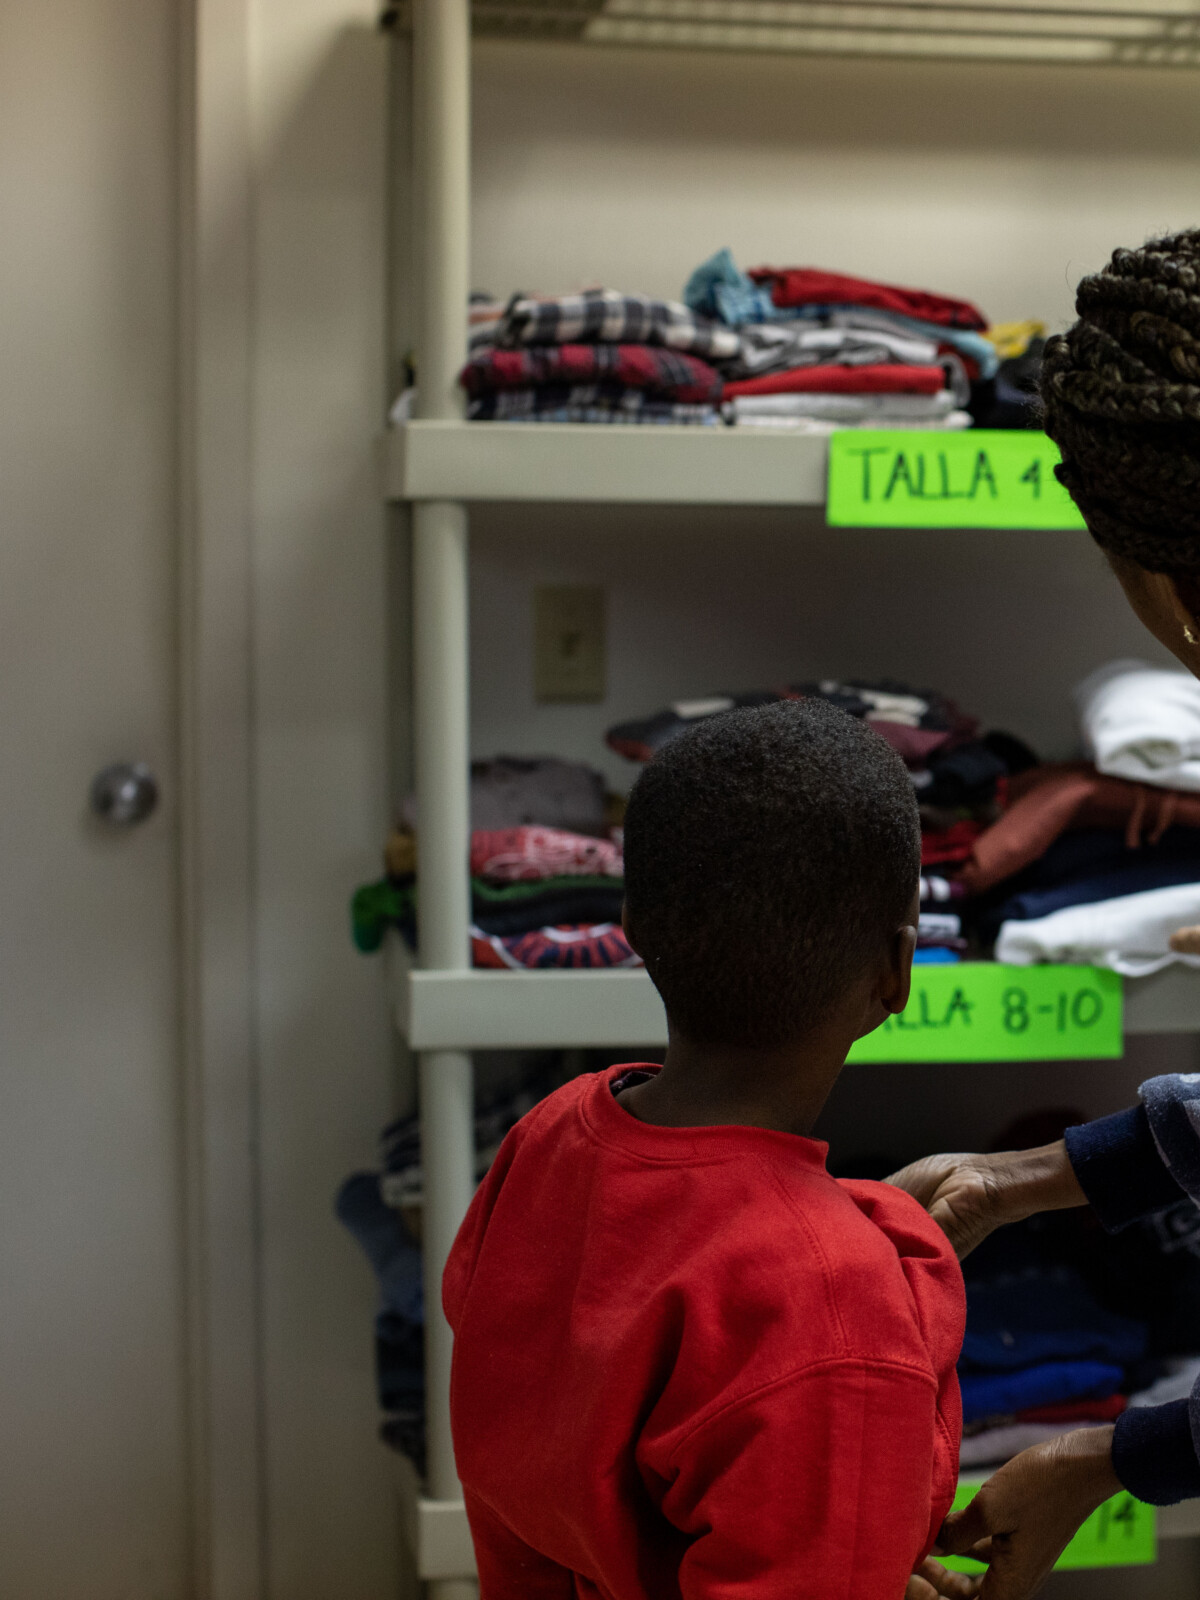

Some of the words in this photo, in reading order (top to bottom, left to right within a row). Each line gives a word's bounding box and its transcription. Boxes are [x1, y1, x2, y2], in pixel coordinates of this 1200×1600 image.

[845, 446, 999, 503] TALLA
[1019, 456, 1041, 500] 4
[883, 986, 975, 1033] LLA
[1002, 986, 1105, 1035] 8-10
